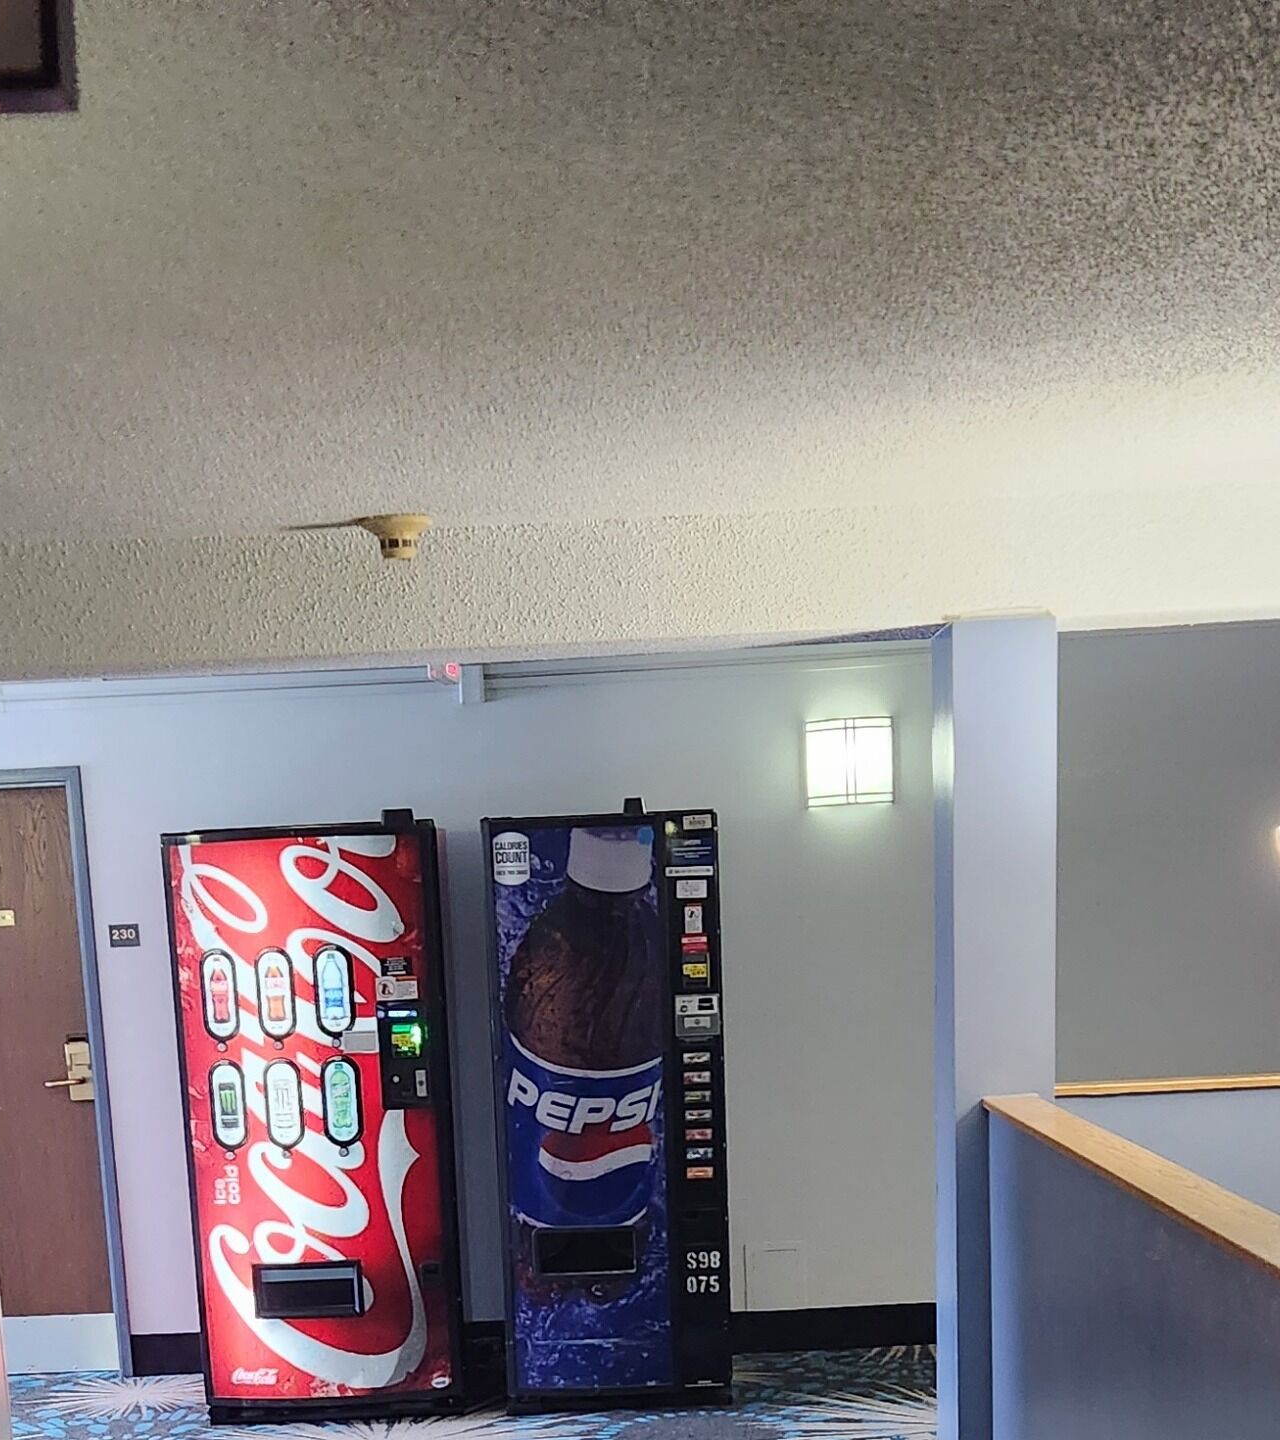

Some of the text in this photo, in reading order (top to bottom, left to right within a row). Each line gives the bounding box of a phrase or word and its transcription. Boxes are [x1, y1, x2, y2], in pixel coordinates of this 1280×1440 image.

[495, 841, 528, 850] CALORIES
[495, 851, 528, 864] COUNT
[111, 929, 136, 940] 230
[507, 1067, 662, 1135] PEPSI
[224, 1165, 241, 1206] cold
[686, 1250, 721, 1270] S98
[686, 1275, 721, 1293] 075
